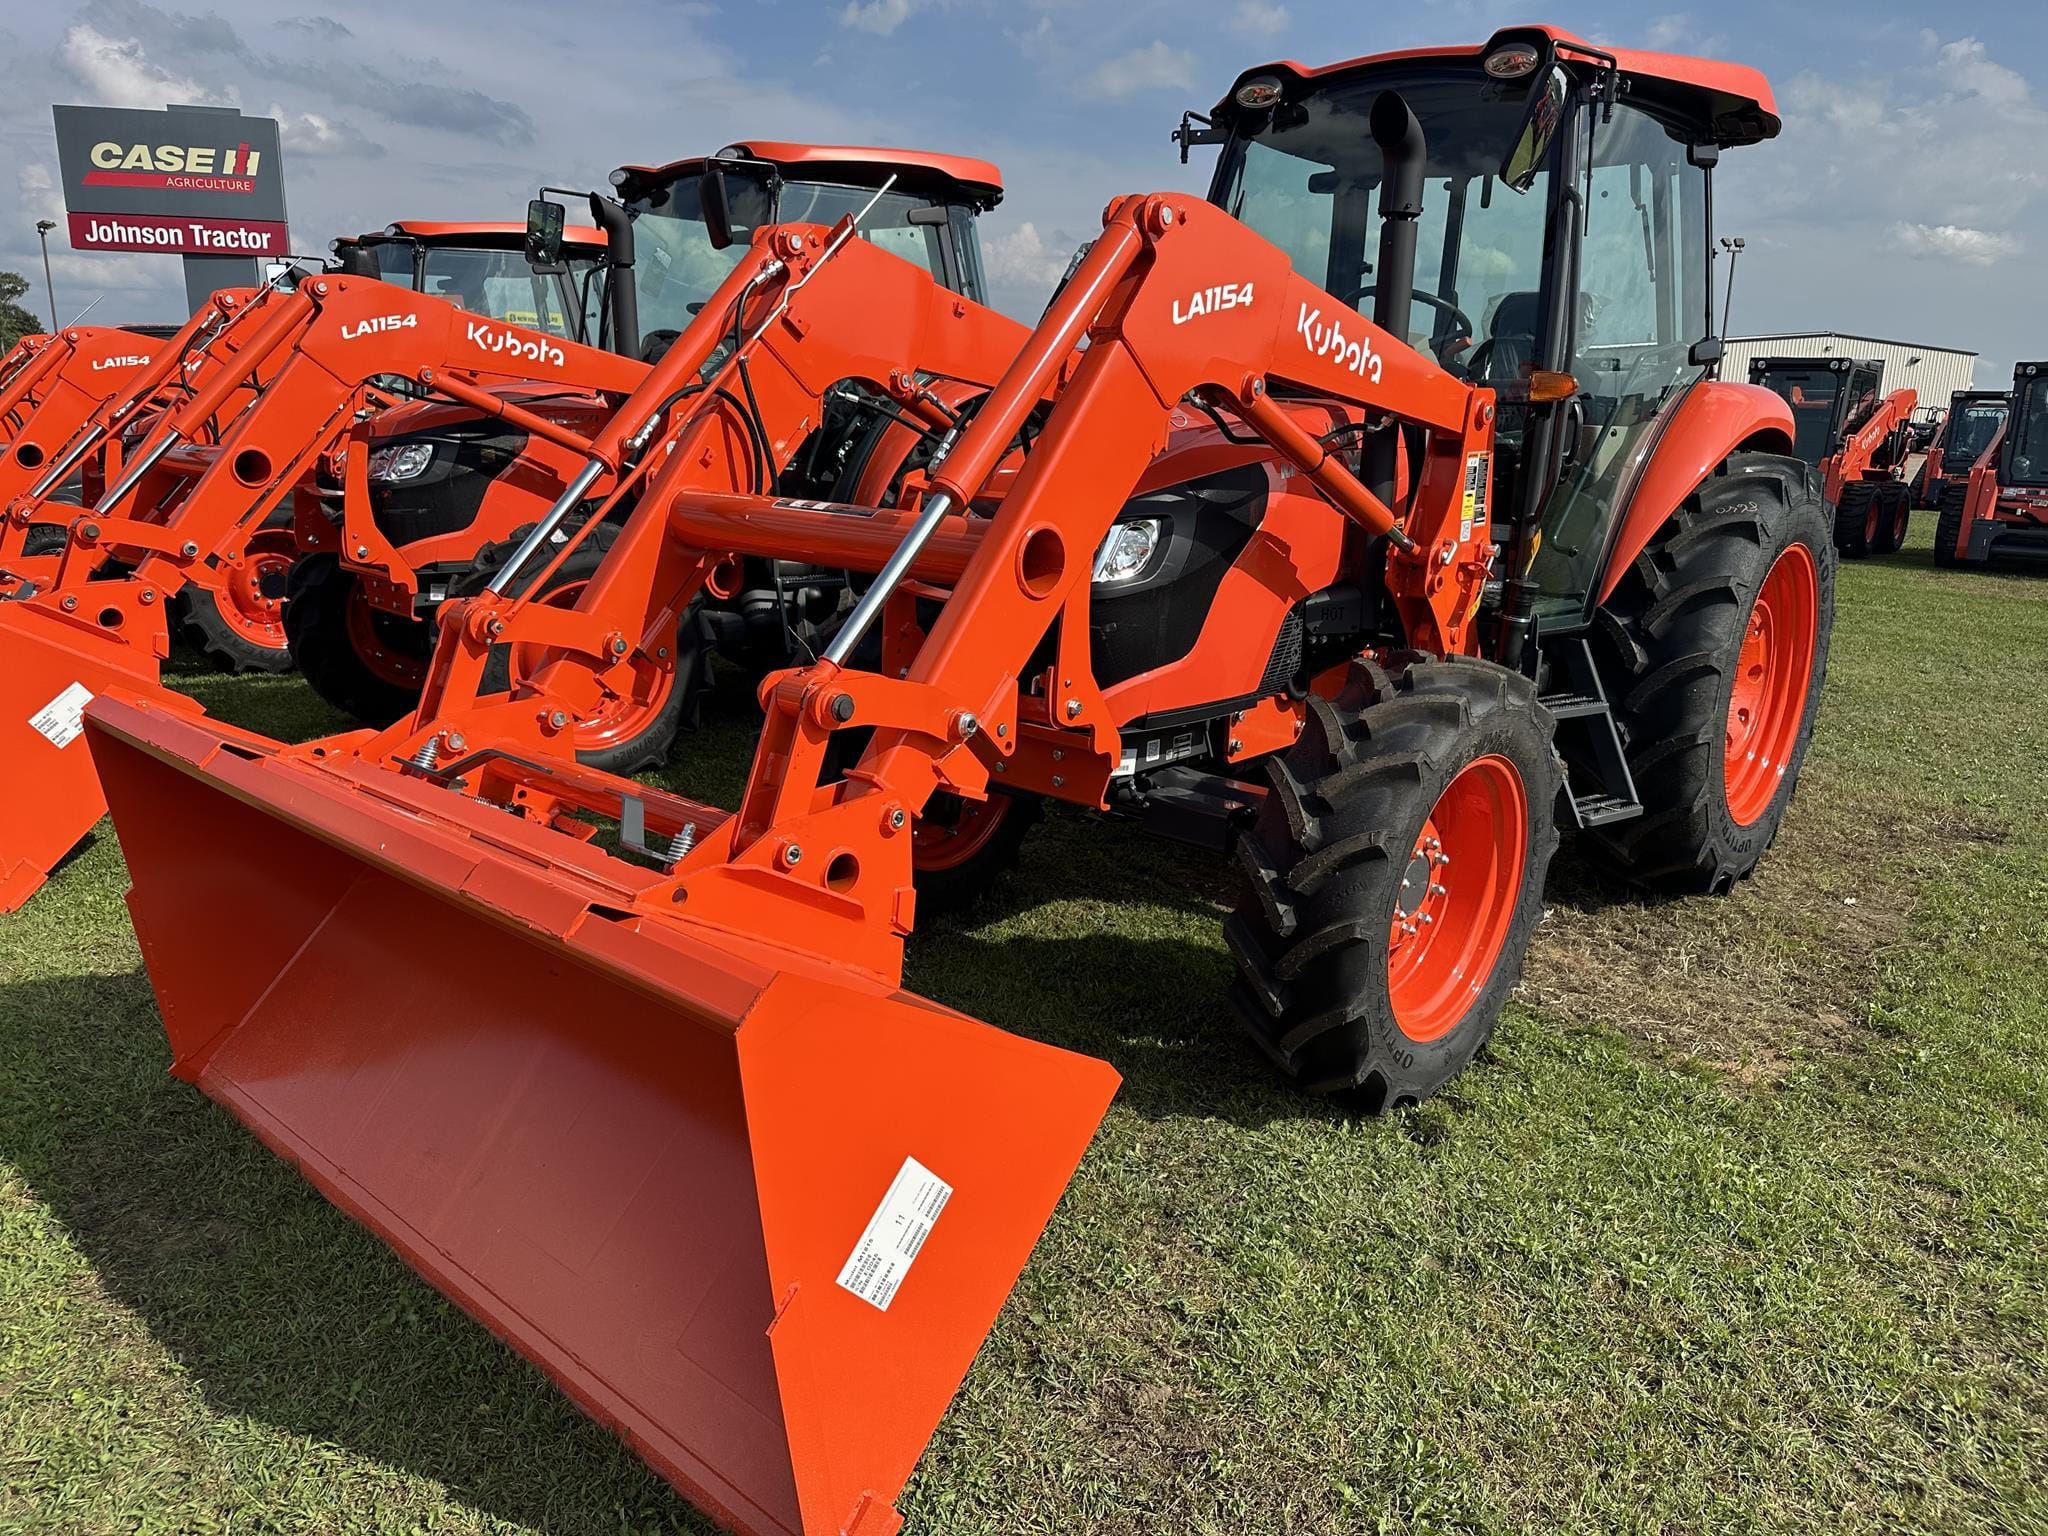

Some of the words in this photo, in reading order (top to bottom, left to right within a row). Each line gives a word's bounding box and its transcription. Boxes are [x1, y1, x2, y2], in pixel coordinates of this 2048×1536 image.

[91, 142, 216, 174] CASE
[166, 177, 251, 191] AGRICULTURE
[85, 220, 183, 245] Johnson
[189, 224, 271, 249] Tractor
[1172, 282, 1254, 325] LA1154
[341, 313, 418, 340] LA1154
[466, 322, 565, 367] Kubota
[1296, 302, 1383, 384] Kubota
[92, 355, 151, 371] LA1154
[1321, 607, 1344, 620] HOT
